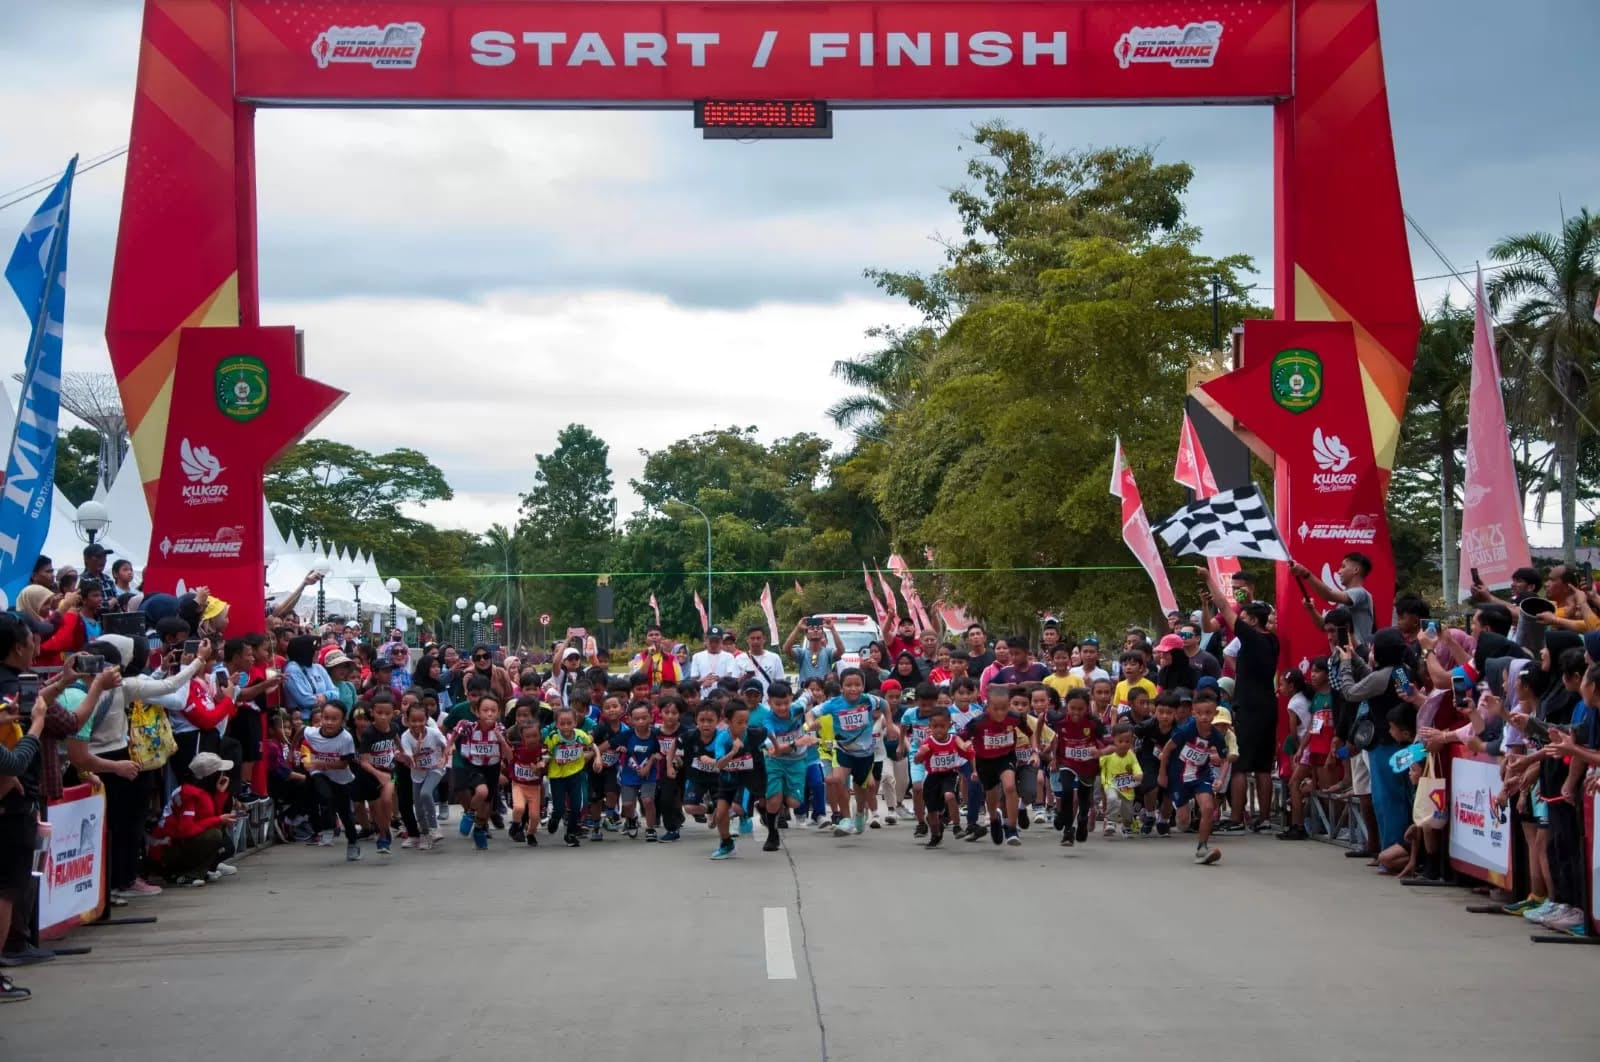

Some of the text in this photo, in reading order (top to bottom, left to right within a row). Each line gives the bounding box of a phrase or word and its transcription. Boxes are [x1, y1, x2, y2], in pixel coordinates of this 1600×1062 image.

[332, 46, 416, 57] RUNNING
[470, 30, 1068, 68] START / FINISH
[1133, 45, 1213, 57] RUNNING
[1310, 528, 1376, 539] RUNNING
[173, 542, 243, 553] RUNNING
[844, 713, 863, 725] 1032
[935, 756, 955, 766] 0954
[1459, 809, 1485, 827] RUNNING
[56, 854, 94, 887] RUNNING
